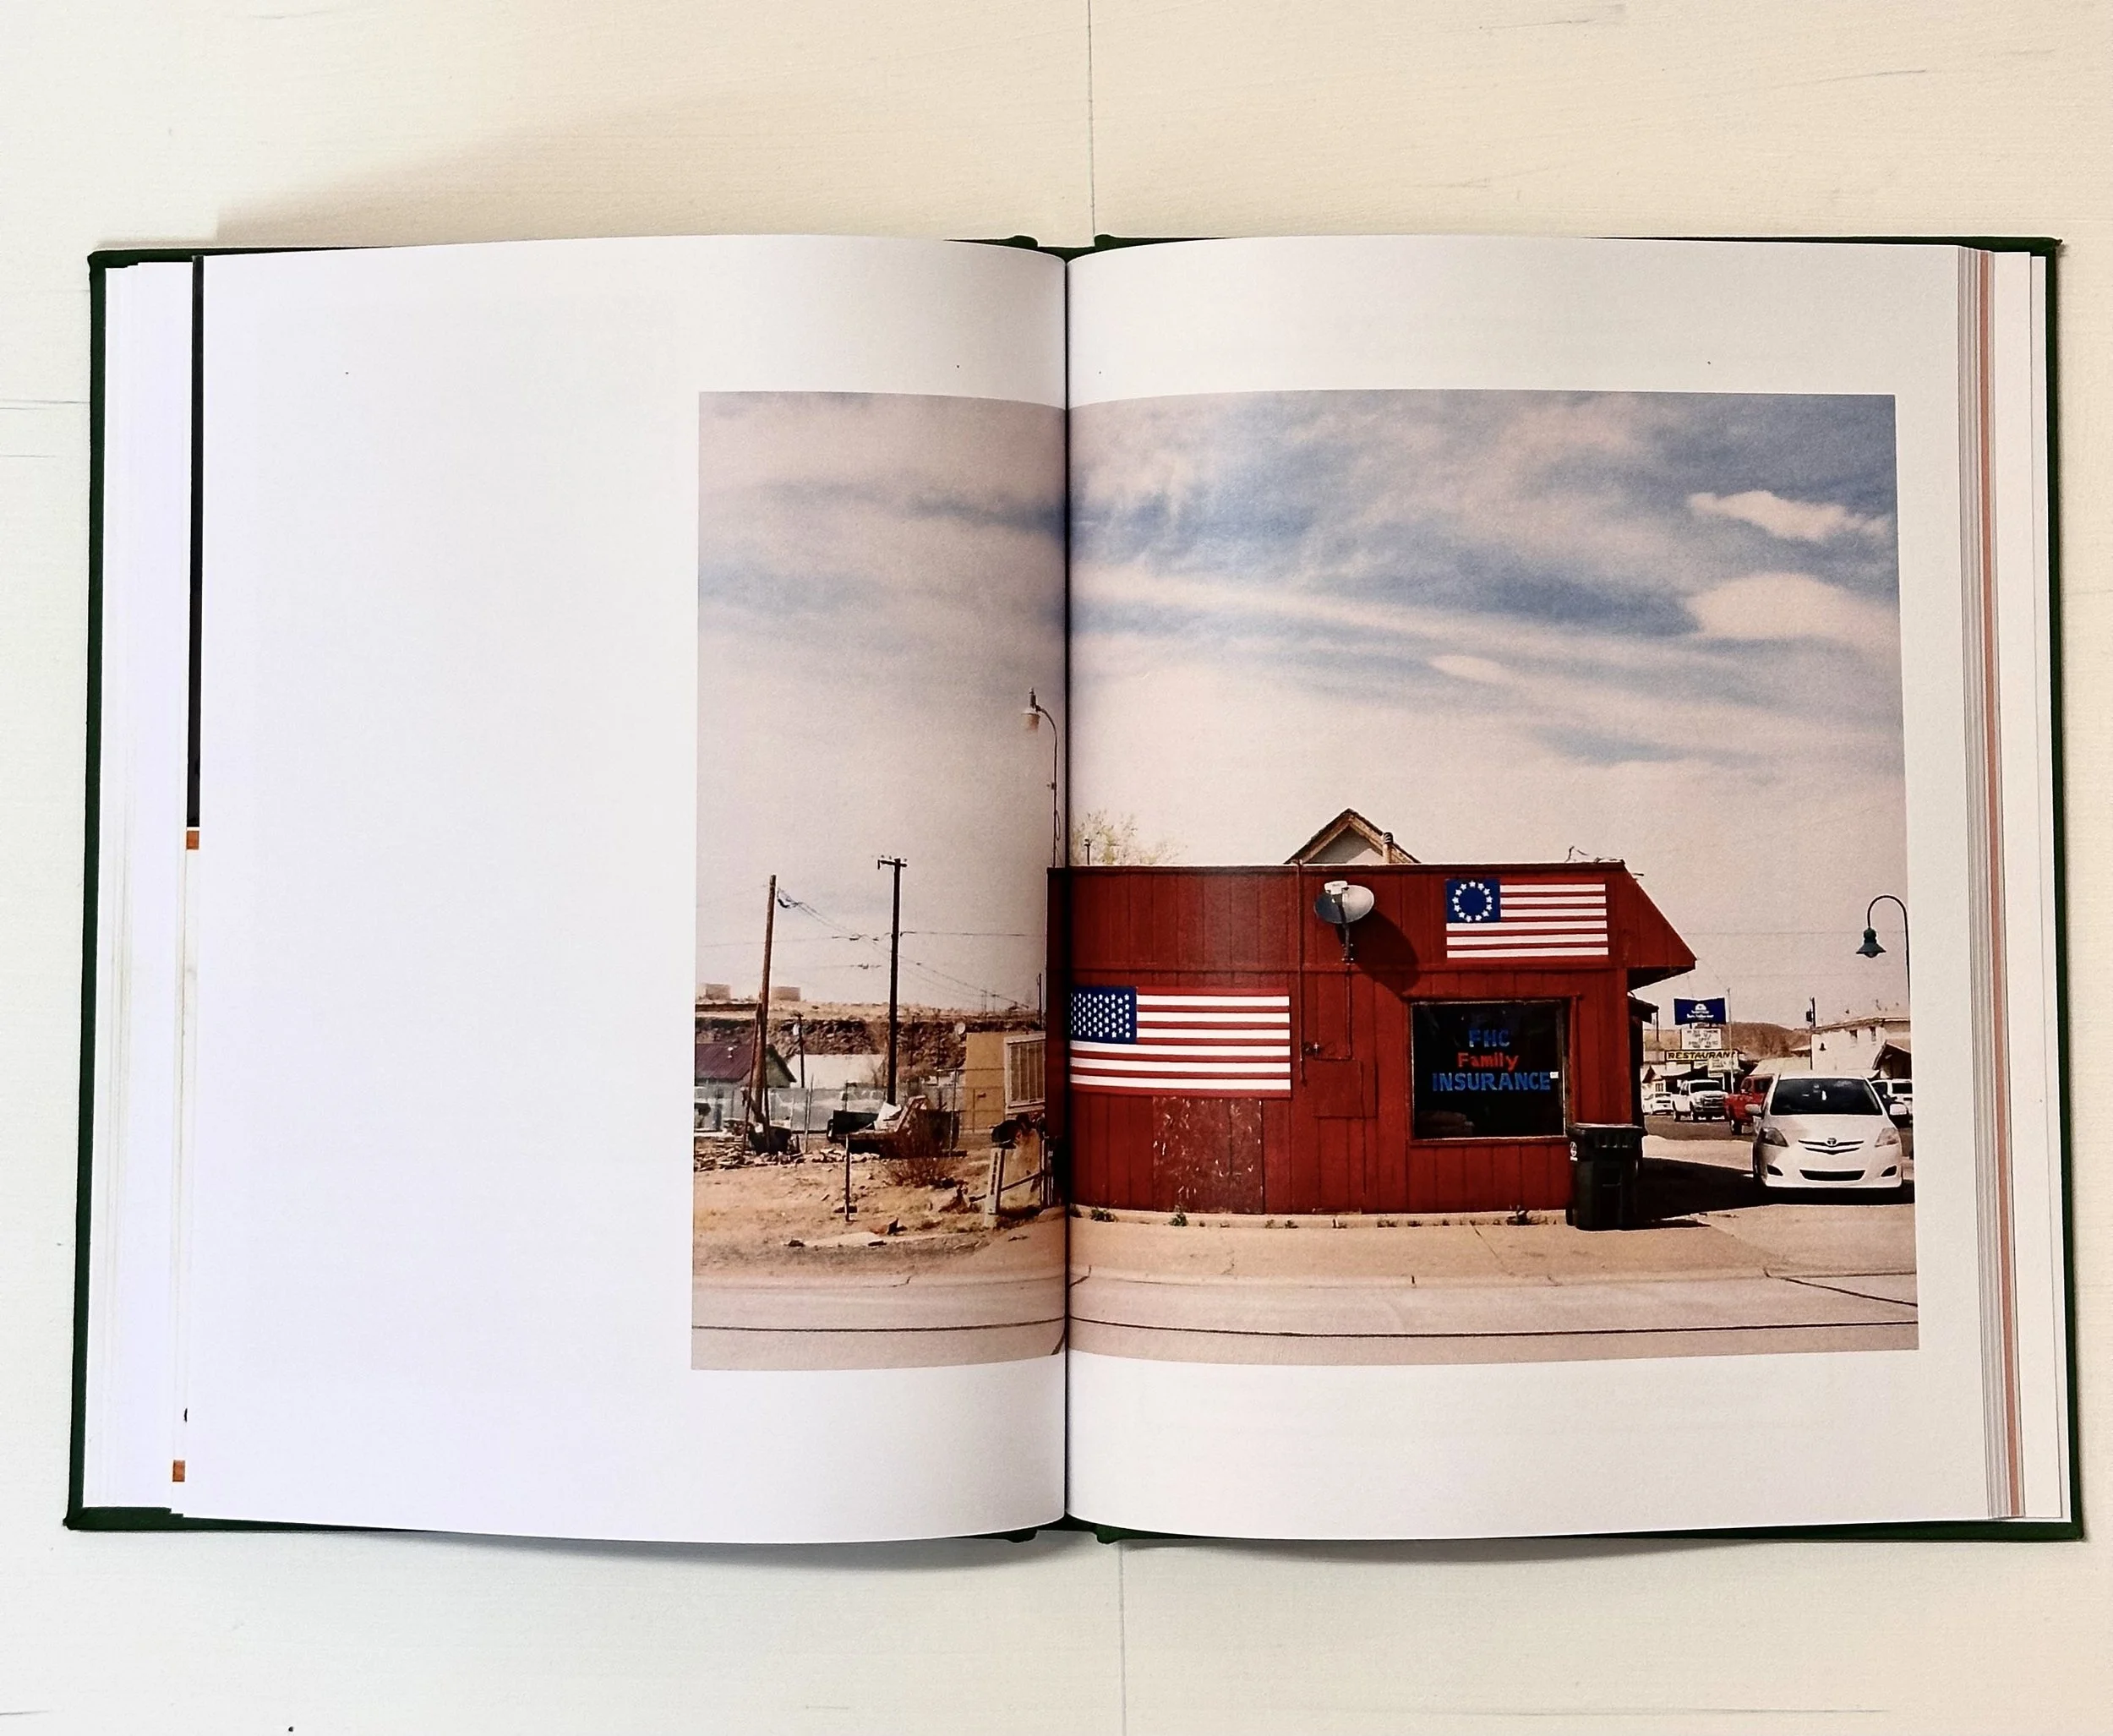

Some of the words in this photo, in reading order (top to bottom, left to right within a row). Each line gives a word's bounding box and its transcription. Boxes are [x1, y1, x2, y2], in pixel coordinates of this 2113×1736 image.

[1469, 1029, 1510, 1047] FHC
[1457, 1052, 1520, 1071] Family
[1432, 1072, 1552, 1092] INSURANCE
